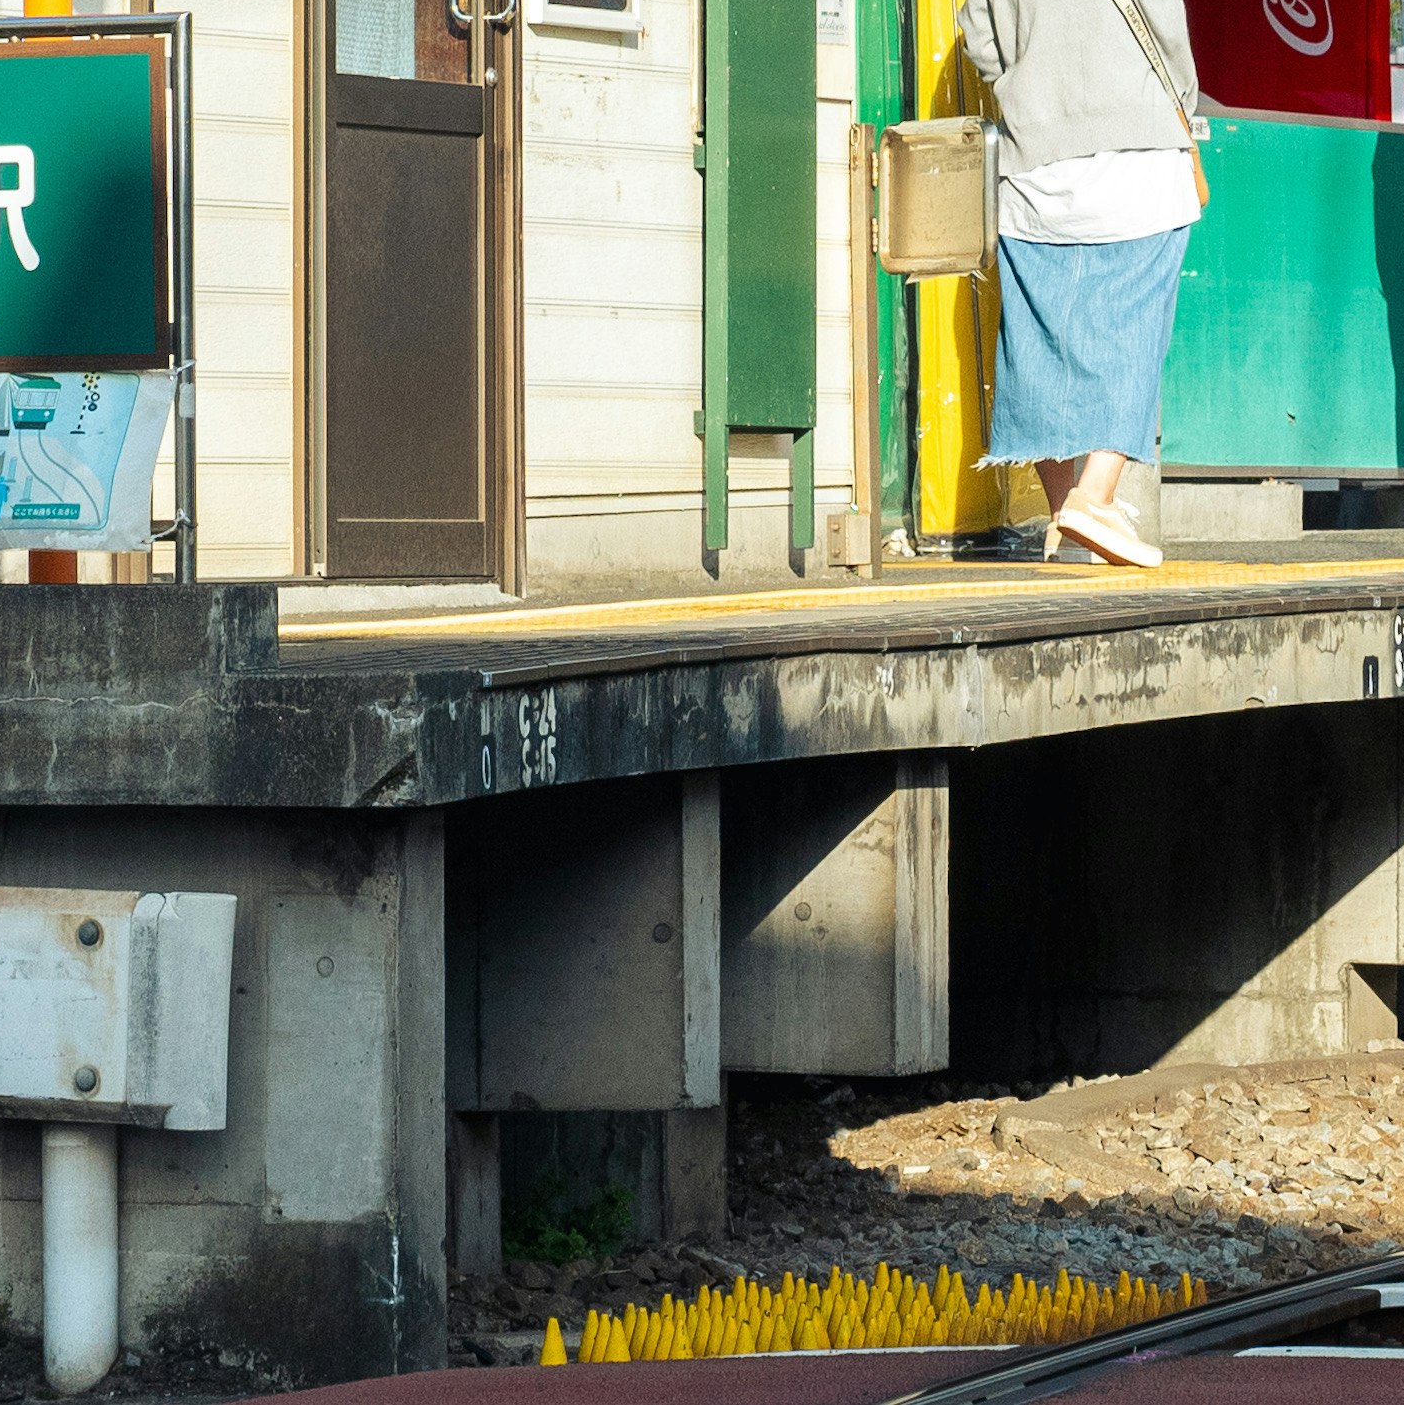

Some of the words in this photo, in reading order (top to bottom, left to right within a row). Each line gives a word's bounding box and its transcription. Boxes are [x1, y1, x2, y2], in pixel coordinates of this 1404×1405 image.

[14, 506, 78, 518] ここでお待ちください
